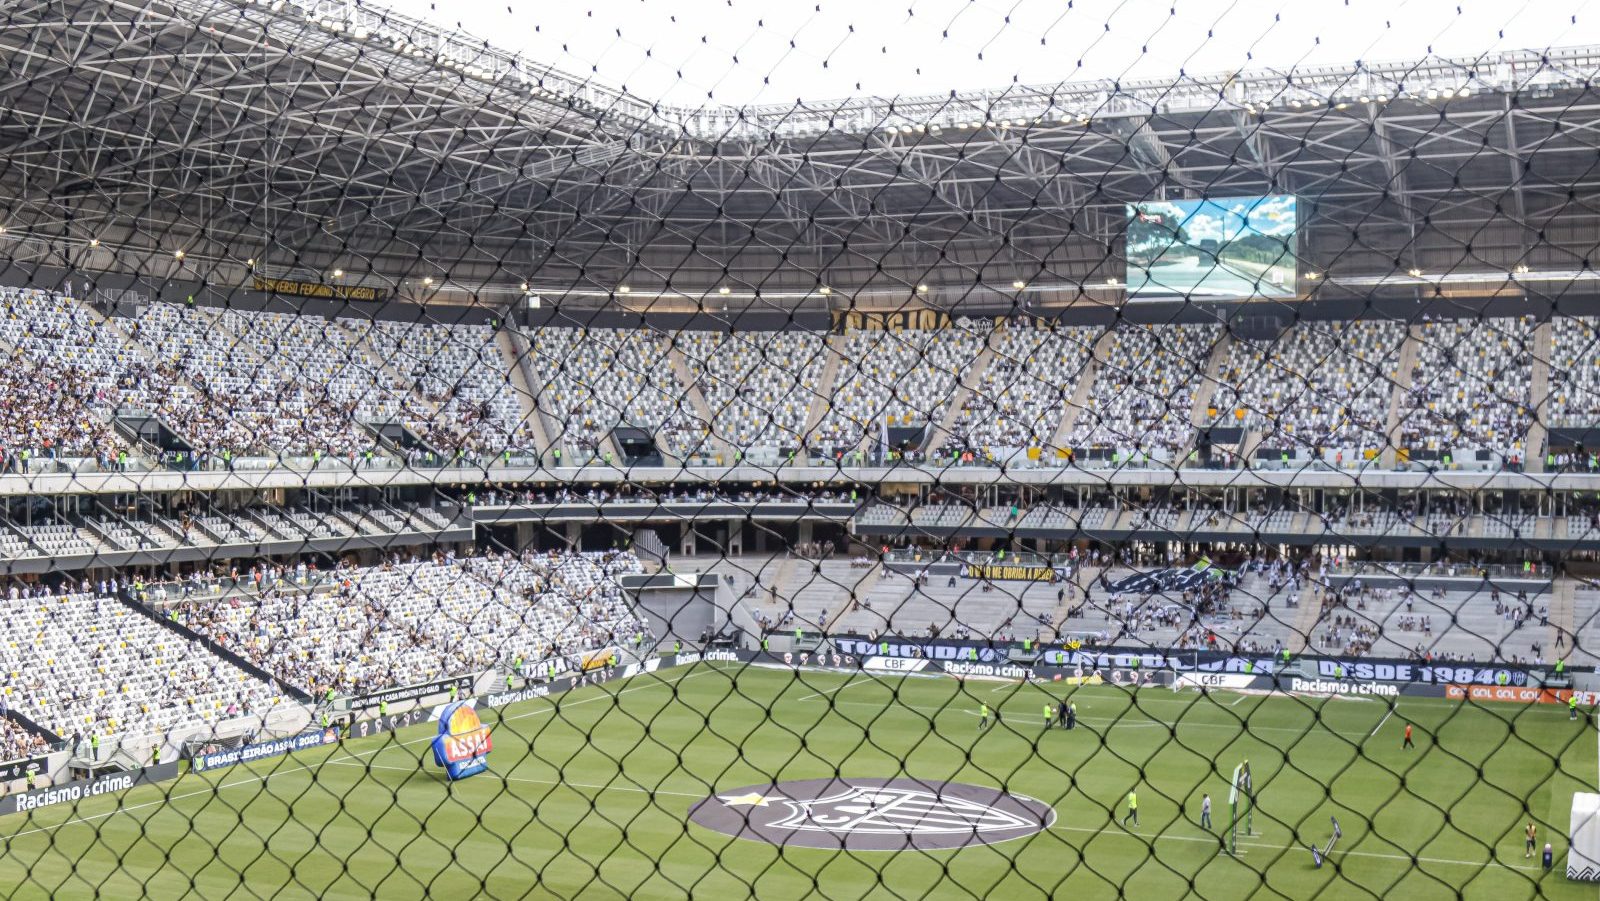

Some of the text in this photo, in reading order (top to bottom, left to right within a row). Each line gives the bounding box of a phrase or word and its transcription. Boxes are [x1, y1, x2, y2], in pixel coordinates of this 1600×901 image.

[884, 659, 905, 669] CBF
[944, 660, 993, 676] Racismo
[1002, 665, 1036, 679] crime.
[1202, 674, 1226, 686] CBF
[1320, 660, 1494, 685] DESDE 1984
[1291, 678, 1349, 693] Racismo
[1359, 681, 1400, 696] crime.
[1473, 688, 1493, 698] GOL
[1496, 690, 1516, 699] GOL
[488, 692, 522, 708] Racismo
[299, 734, 320, 747] 2023
[16, 785, 80, 812] Racismo
[92, 775, 134, 795] crime.
